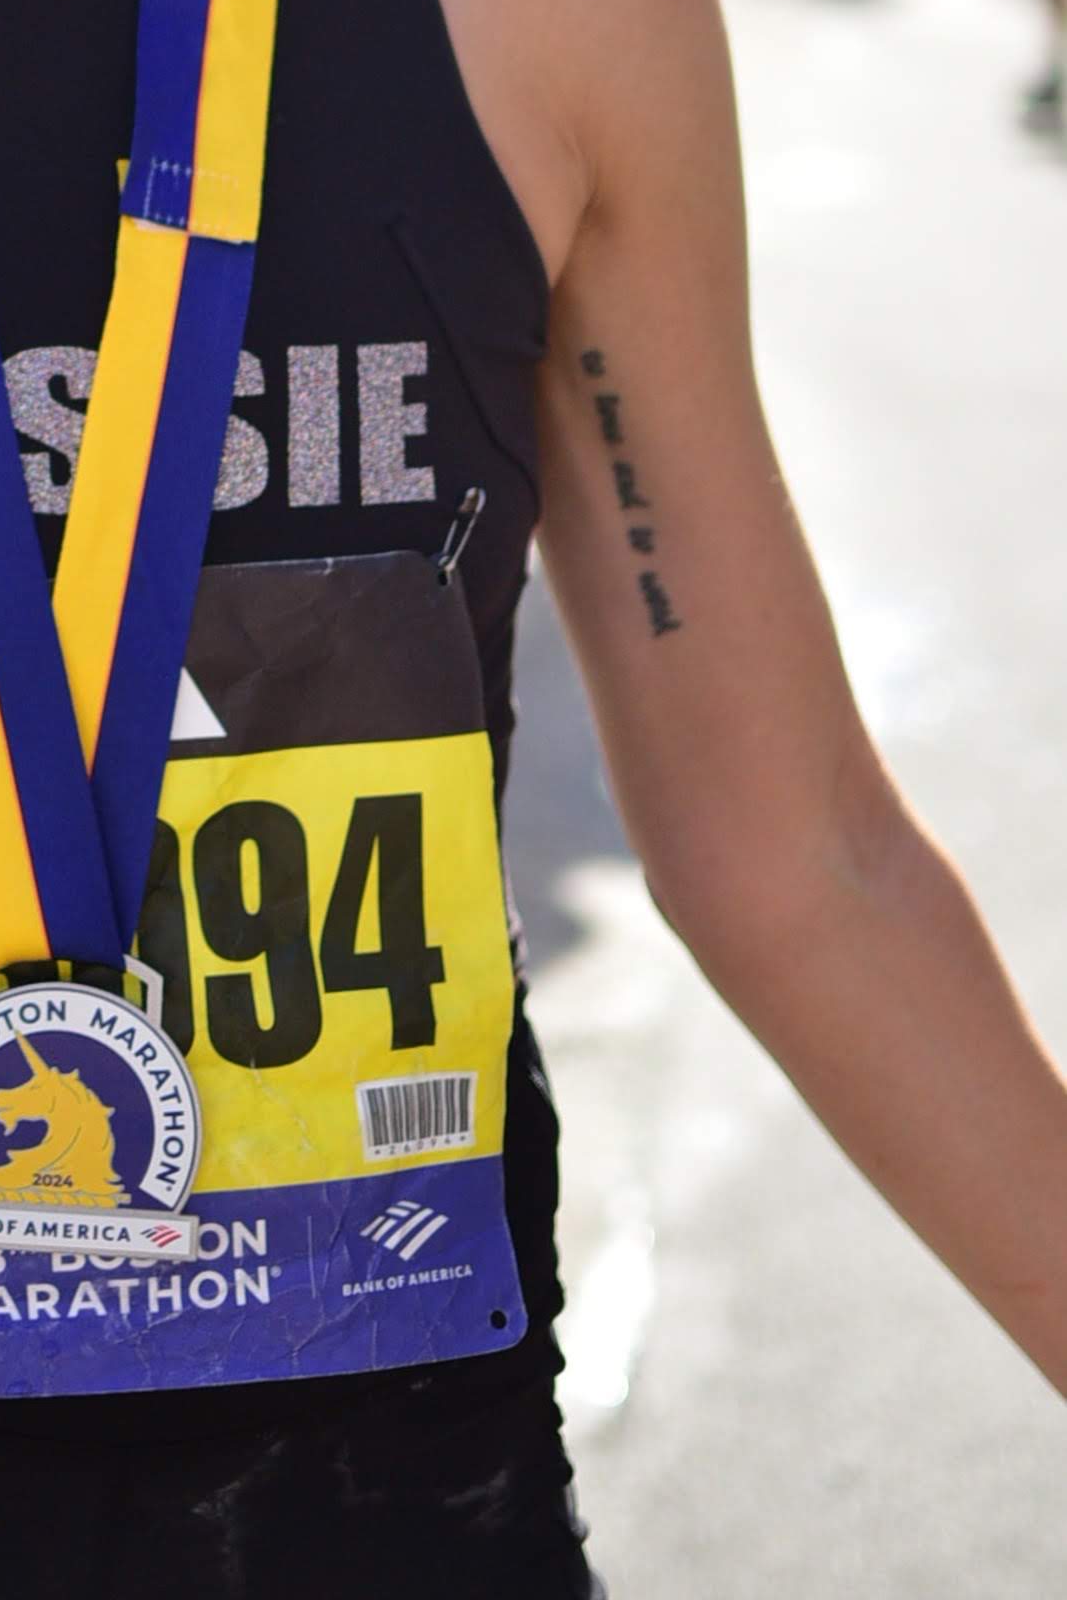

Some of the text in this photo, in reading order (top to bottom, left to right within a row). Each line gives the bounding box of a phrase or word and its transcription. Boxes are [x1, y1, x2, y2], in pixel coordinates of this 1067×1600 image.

[90, 1007, 186, 1186] MARATHON
[33, 1174, 74, 1188] 2024
[23, 1221, 131, 1243] AMERICA
[342, 1264, 474, 1297] BANK OF AMERICA
